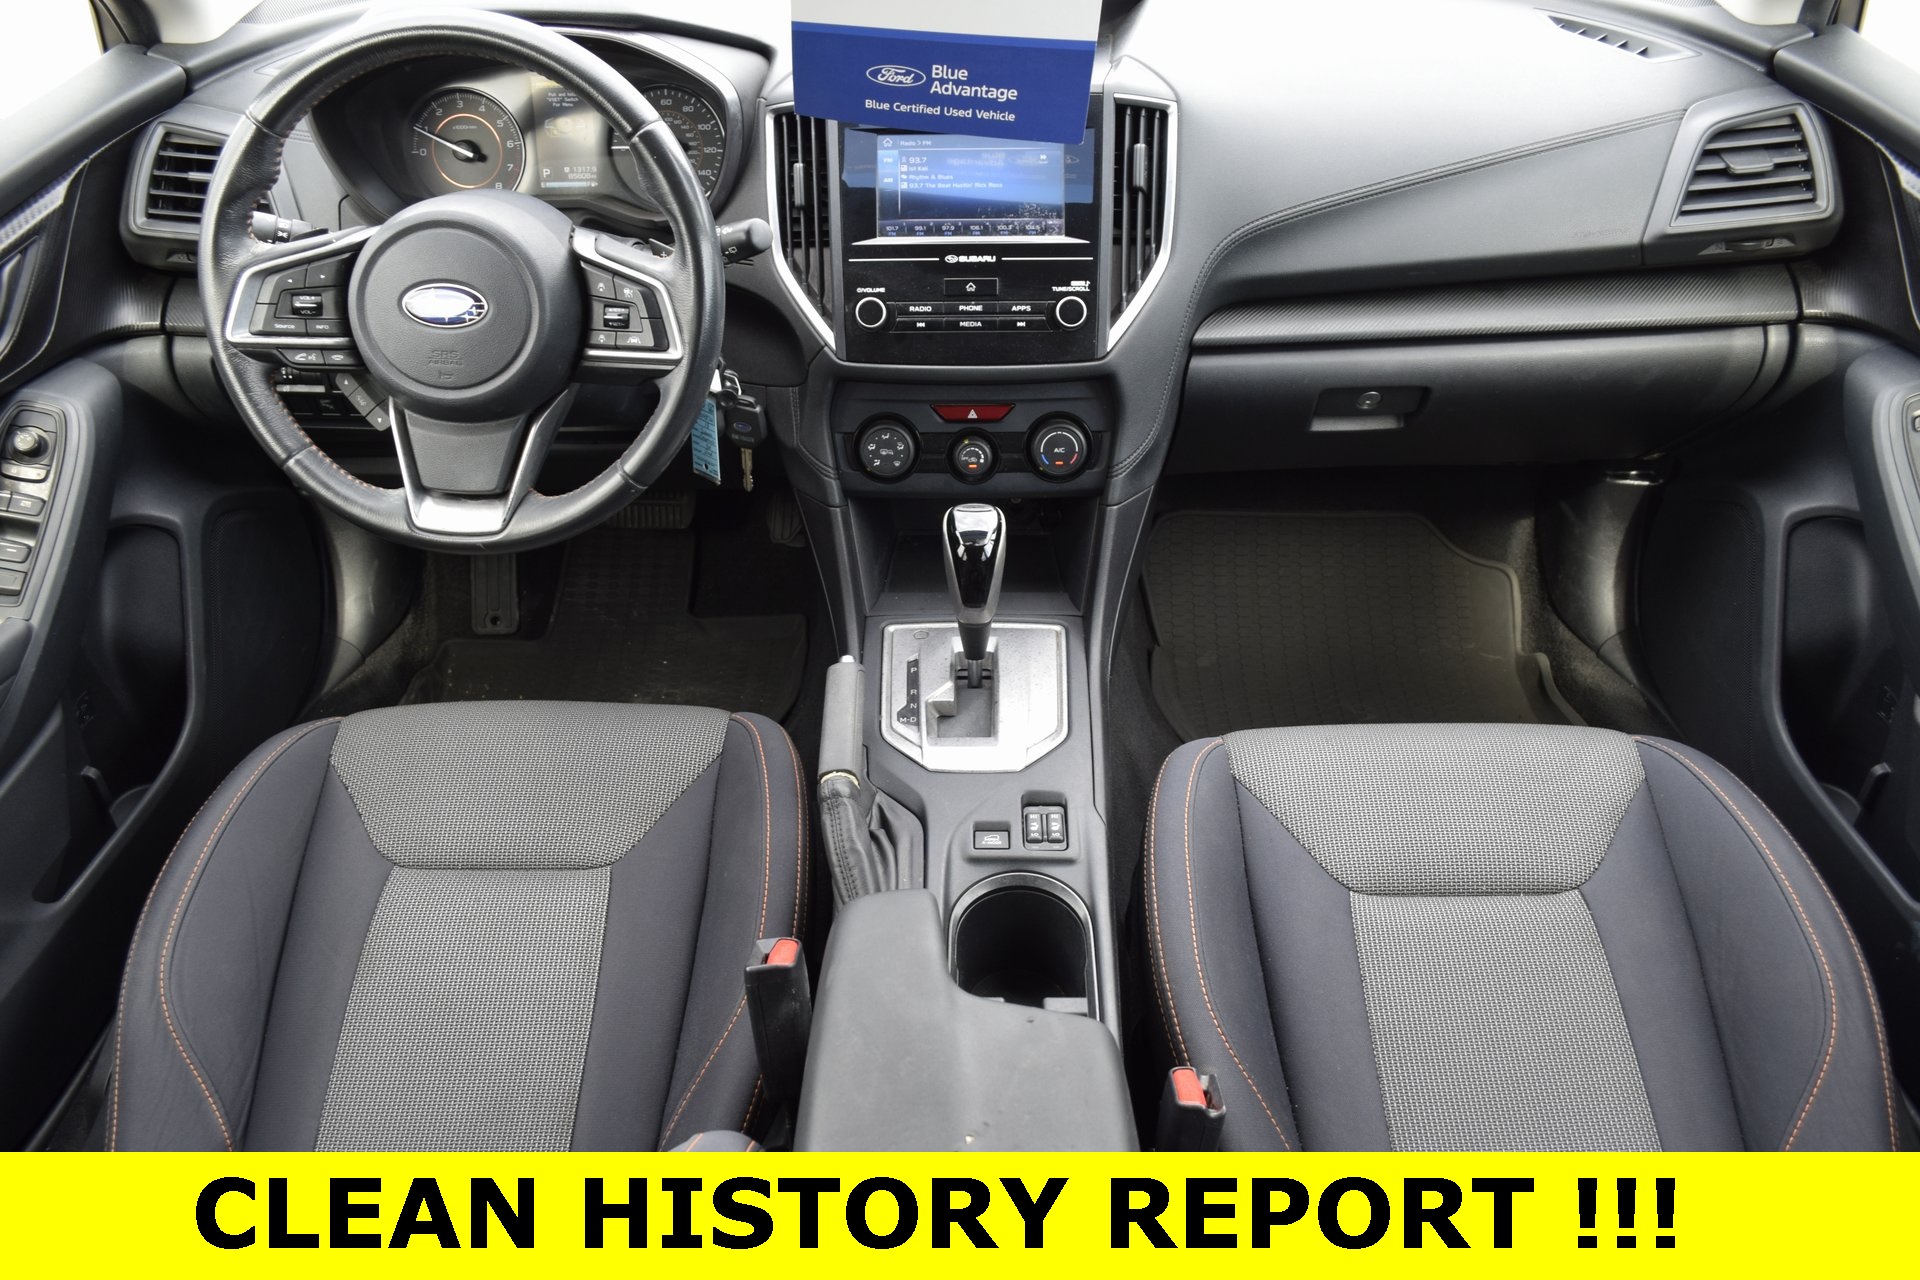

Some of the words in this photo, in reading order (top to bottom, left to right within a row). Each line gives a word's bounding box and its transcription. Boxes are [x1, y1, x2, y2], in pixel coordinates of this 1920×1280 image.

[877, 67, 915, 85] Ford
[931, 64, 969, 81] Blue
[929, 80, 1018, 102] Advantage
[660, 98, 672, 106] 60
[435, 108, 443, 116] 2
[865, 99, 890, 111] Blue
[893, 102, 941, 116] Certified
[944, 106, 972, 118] Used
[975, 109, 1016, 122] Vehicle
[496, 119, 504, 127] 5
[506, 140, 514, 148] 6
[420, 148, 427, 156] 0
[703, 146, 717, 154] 120
[507, 163, 514, 172] 7
[542, 168, 551, 178] P
[495, 182, 503, 190] 8
[958, 255, 996, 263] SUBARU
[959, 304, 983, 312] PHONE
[959, 320, 982, 328] MEDIA
